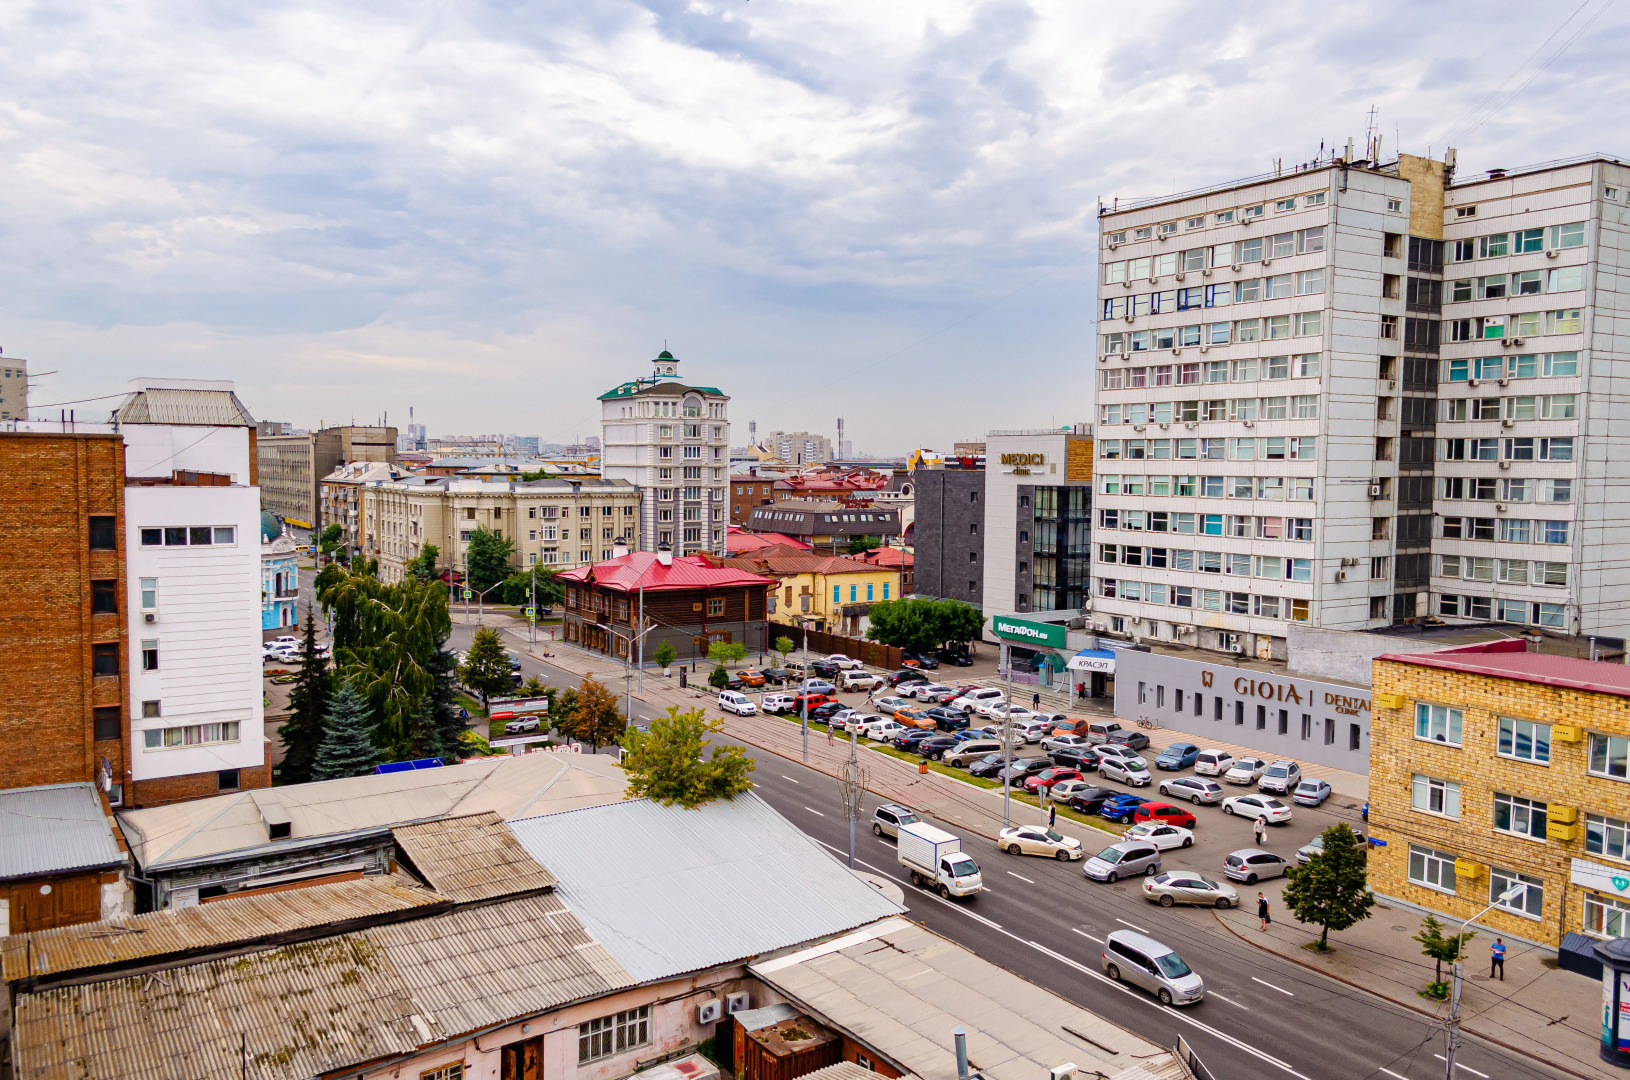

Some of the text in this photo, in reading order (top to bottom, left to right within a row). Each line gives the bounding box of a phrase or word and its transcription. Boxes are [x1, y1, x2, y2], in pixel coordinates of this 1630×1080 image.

[1001, 453, 1043, 465] MEDICI
[1013, 467, 1031, 475] clinic
[1234, 676, 1303, 706] GIOIA
[1335, 706, 1360, 717] CLINIC
